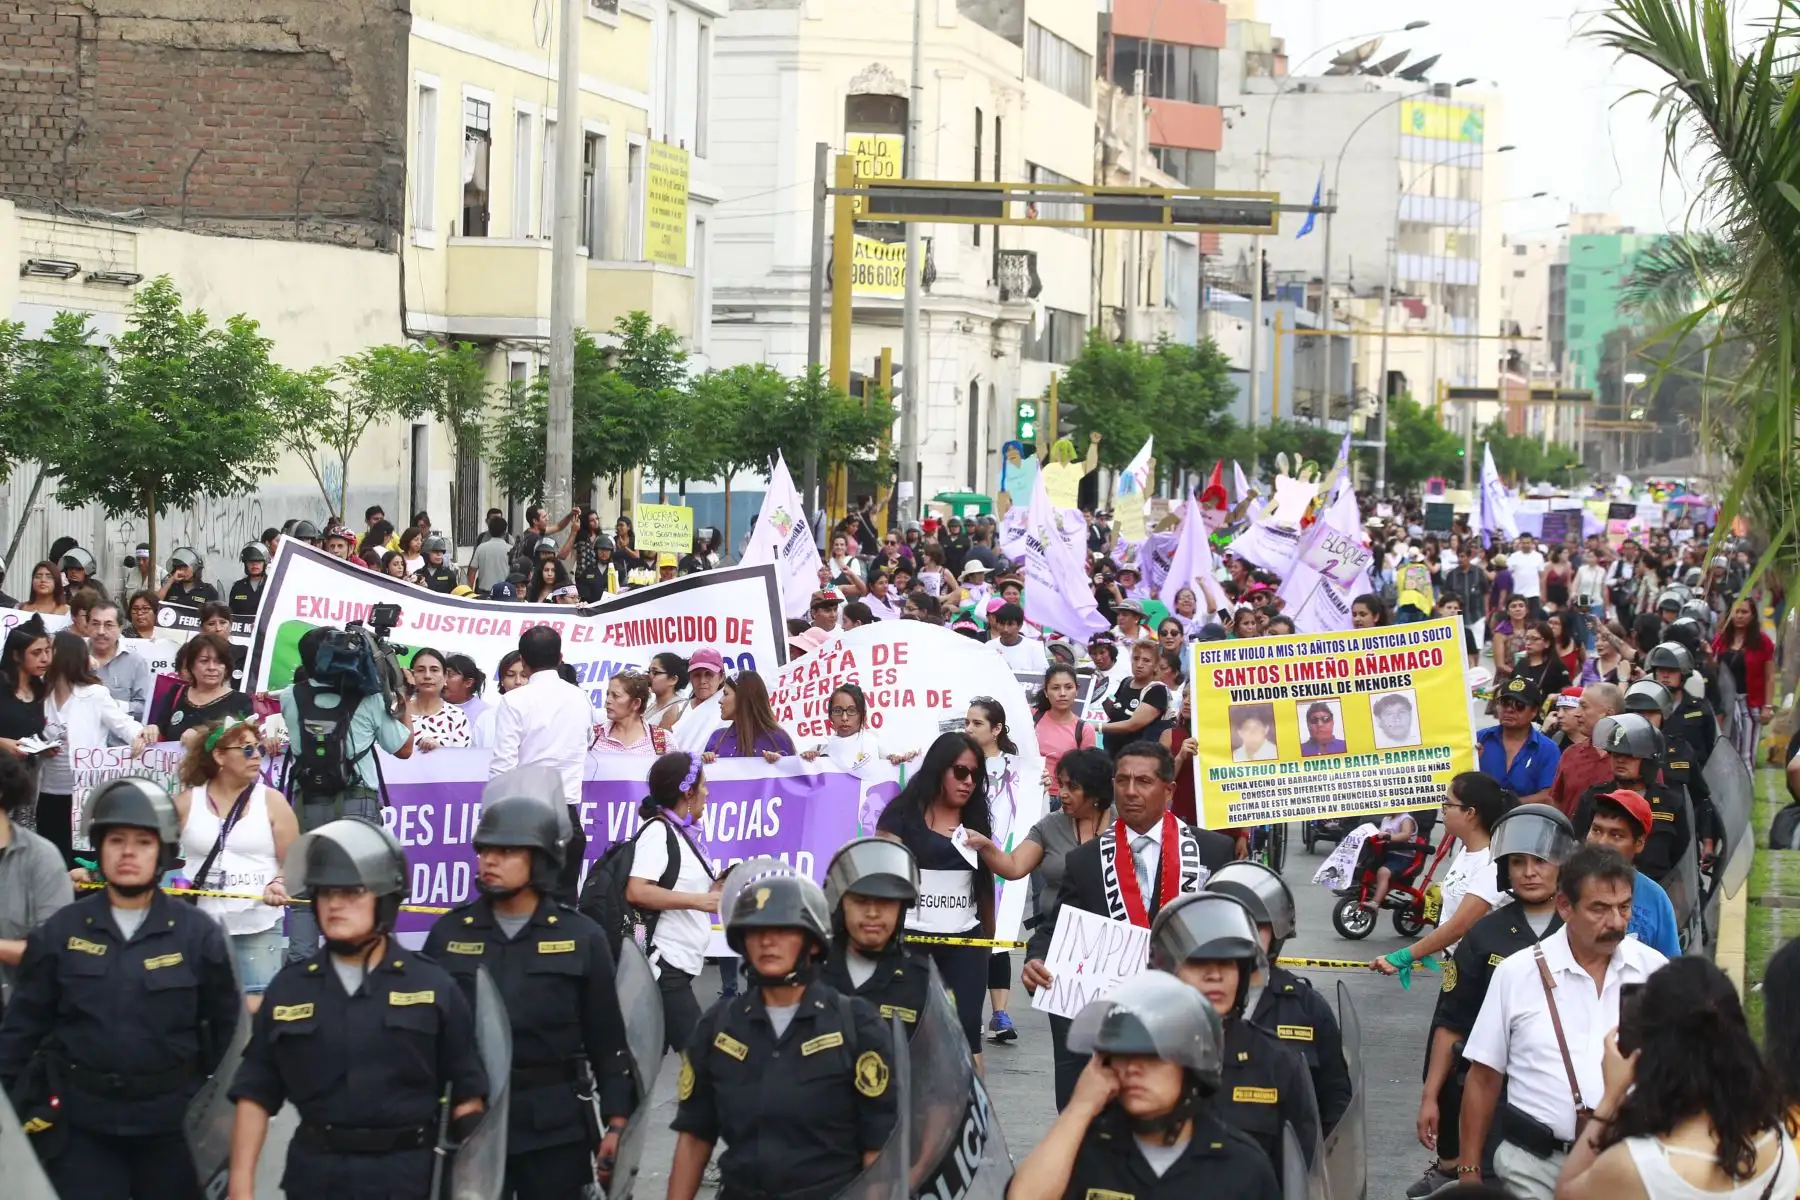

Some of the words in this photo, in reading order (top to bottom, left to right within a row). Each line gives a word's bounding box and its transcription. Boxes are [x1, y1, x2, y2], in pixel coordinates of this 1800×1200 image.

[854, 242, 907, 262] ALQUI
[1321, 531, 1369, 567] BLOQUE
[1319, 558, 1340, 580] 2
[178, 615, 202, 627] FEDE
[296, 595, 403, 629] EXIJIMS
[411, 612, 512, 637] JUSTICIA
[571, 624, 594, 642] EL
[602, 615, 717, 648] FEMINICIDIO
[725, 617, 754, 645] DE
[1200, 649, 1221, 664] ESTE
[1223, 648, 1236, 662] ME
[1238, 645, 1265, 661] VIOLO
[1267, 645, 1274, 658] A
[1276, 643, 1294, 658] MIS
[1296, 642, 1308, 657] 13
[1310, 638, 1346, 655] AÑITOS
[1347, 638, 1359, 652] LA
[1362, 633, 1406, 650] JUSTICIA
[1408, 631, 1420, 645] LO
[1422, 626, 1452, 643] SOLTO
[778, 649, 857, 688] TRATA
[871, 641, 909, 667] DE
[1213, 664, 1281, 688] SANTOS
[1284, 656, 1349, 682] LIMEÑO
[1354, 647, 1443, 676] AÑAMACO
[768, 671, 861, 706] MUJERES
[873, 667, 898, 687] ES
[925, 689, 953, 709] DE
[1230, 686, 1288, 703] VIOLADOR
[1291, 681, 1334, 698] SEXUAL
[1337, 680, 1352, 694] DE
[1354, 674, 1412, 692] MENORES
[1209, 763, 1276, 781] MONSTRUO
[1280, 761, 1301, 774] DEL
[1303, 757, 1341, 772] OVALO
[1277, 777, 1286, 786] DE
[1288, 773, 1328, 785] BARRANCO
[1362, 768, 1377, 778] CON
[1379, 764, 1416, 776] VIOLADOR
[1417, 763, 1427, 772] DE
[1228, 801, 1260, 812] VICTIMA
[1261, 800, 1270, 809] DE
[1271, 798, 1288, 808] ESTE
[1290, 795, 1331, 807] MONSTRUO
[1389, 786, 1414, 797] BUSCA
[1416, 785, 1434, 794] PARA
[1436, 783, 1446, 792] SU
[1241, 789, 1276, 800] CONOSCA
[1277, 787, 1293, 796] SUS
[1294, 783, 1336, 795] DIFERENTES
[1382, 776, 1406, 786] USTED
[1407, 776, 1413, 784] A
[1414, 774, 1432, 784] SIDO
[1282, 806, 1316, 817] SOLADOR
[1317, 805, 1327, 814] EN
[1341, 800, 1382, 812] BOLOGNESI
[1390, 797, 1405, 807] 934
[920, 894, 967, 909] EGURIDAD
